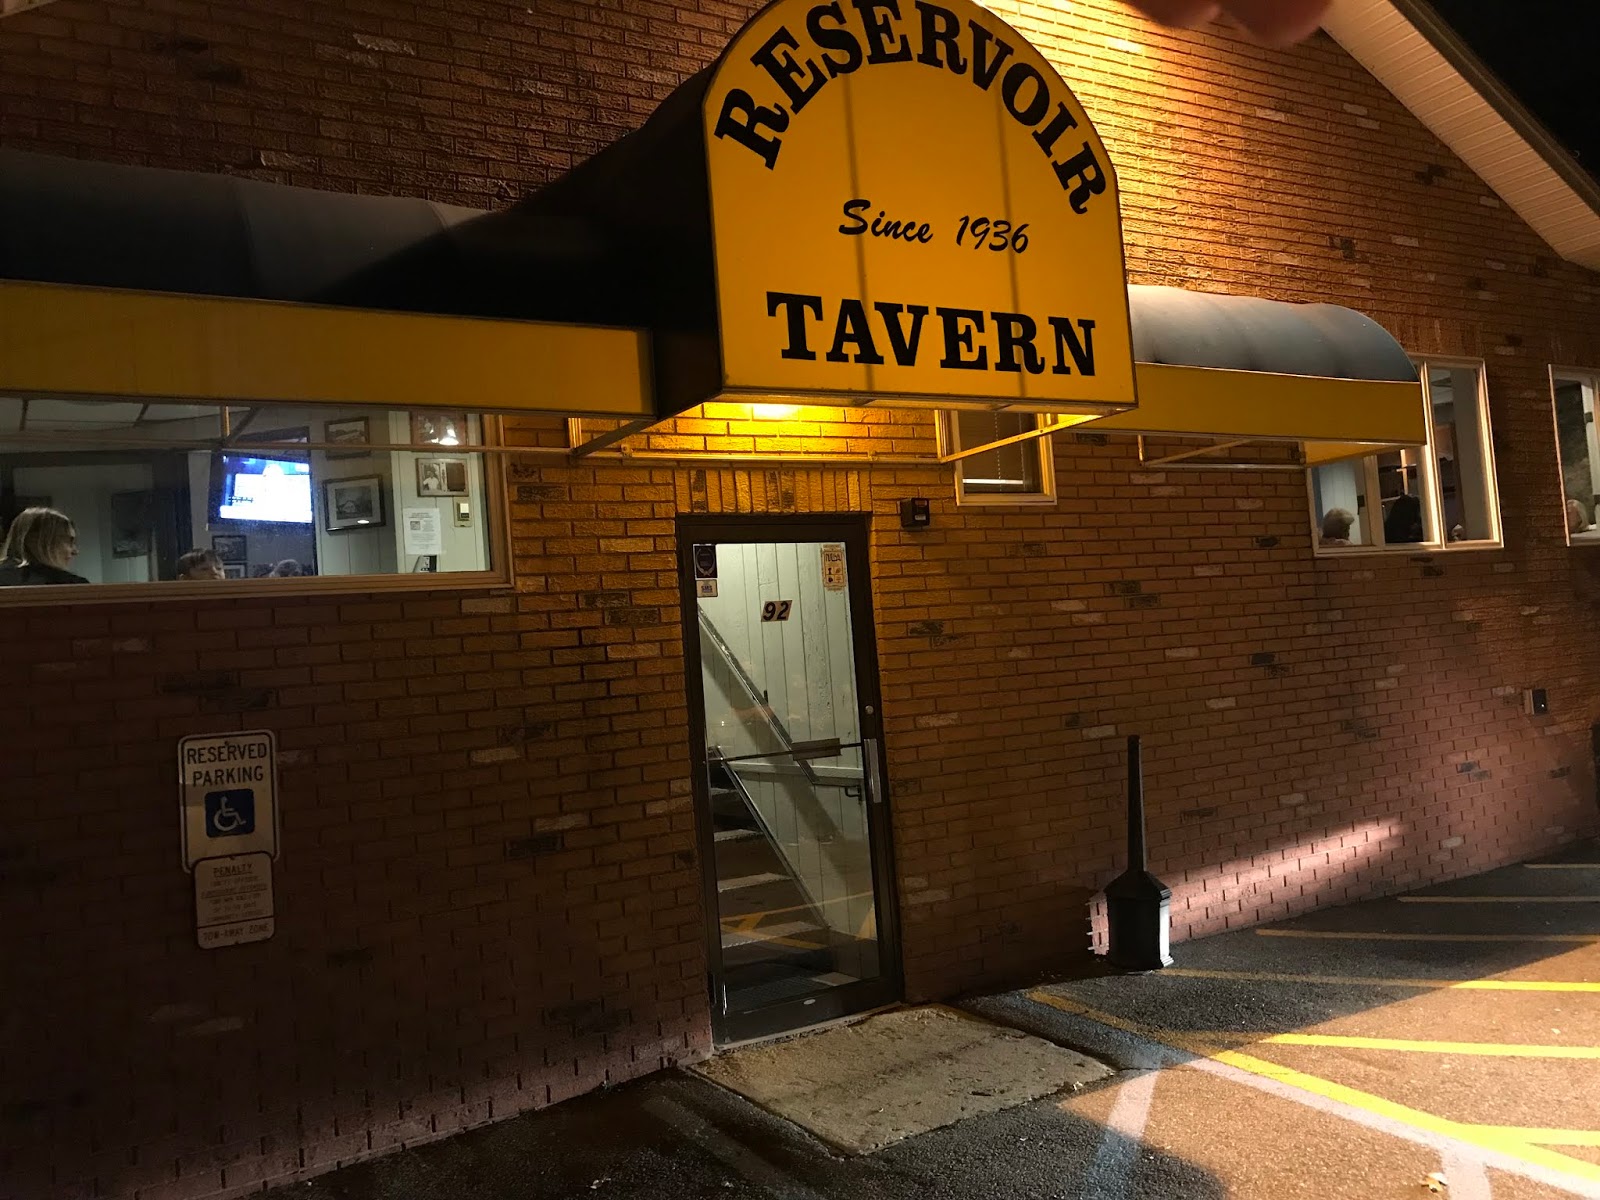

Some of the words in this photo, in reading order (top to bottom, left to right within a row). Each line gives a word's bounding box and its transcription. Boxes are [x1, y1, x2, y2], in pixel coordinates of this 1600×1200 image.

[713, 0, 1107, 215] RESERVOIR
[838, 199, 933, 244] Since
[955, 214, 1030, 254] 1936
[766, 291, 1096, 377] TAVERN
[763, 601, 789, 621] 92
[186, 743, 267, 765] RESERVED
[192, 765, 264, 788] PARKING
[213, 864, 253, 877] PENALTY
